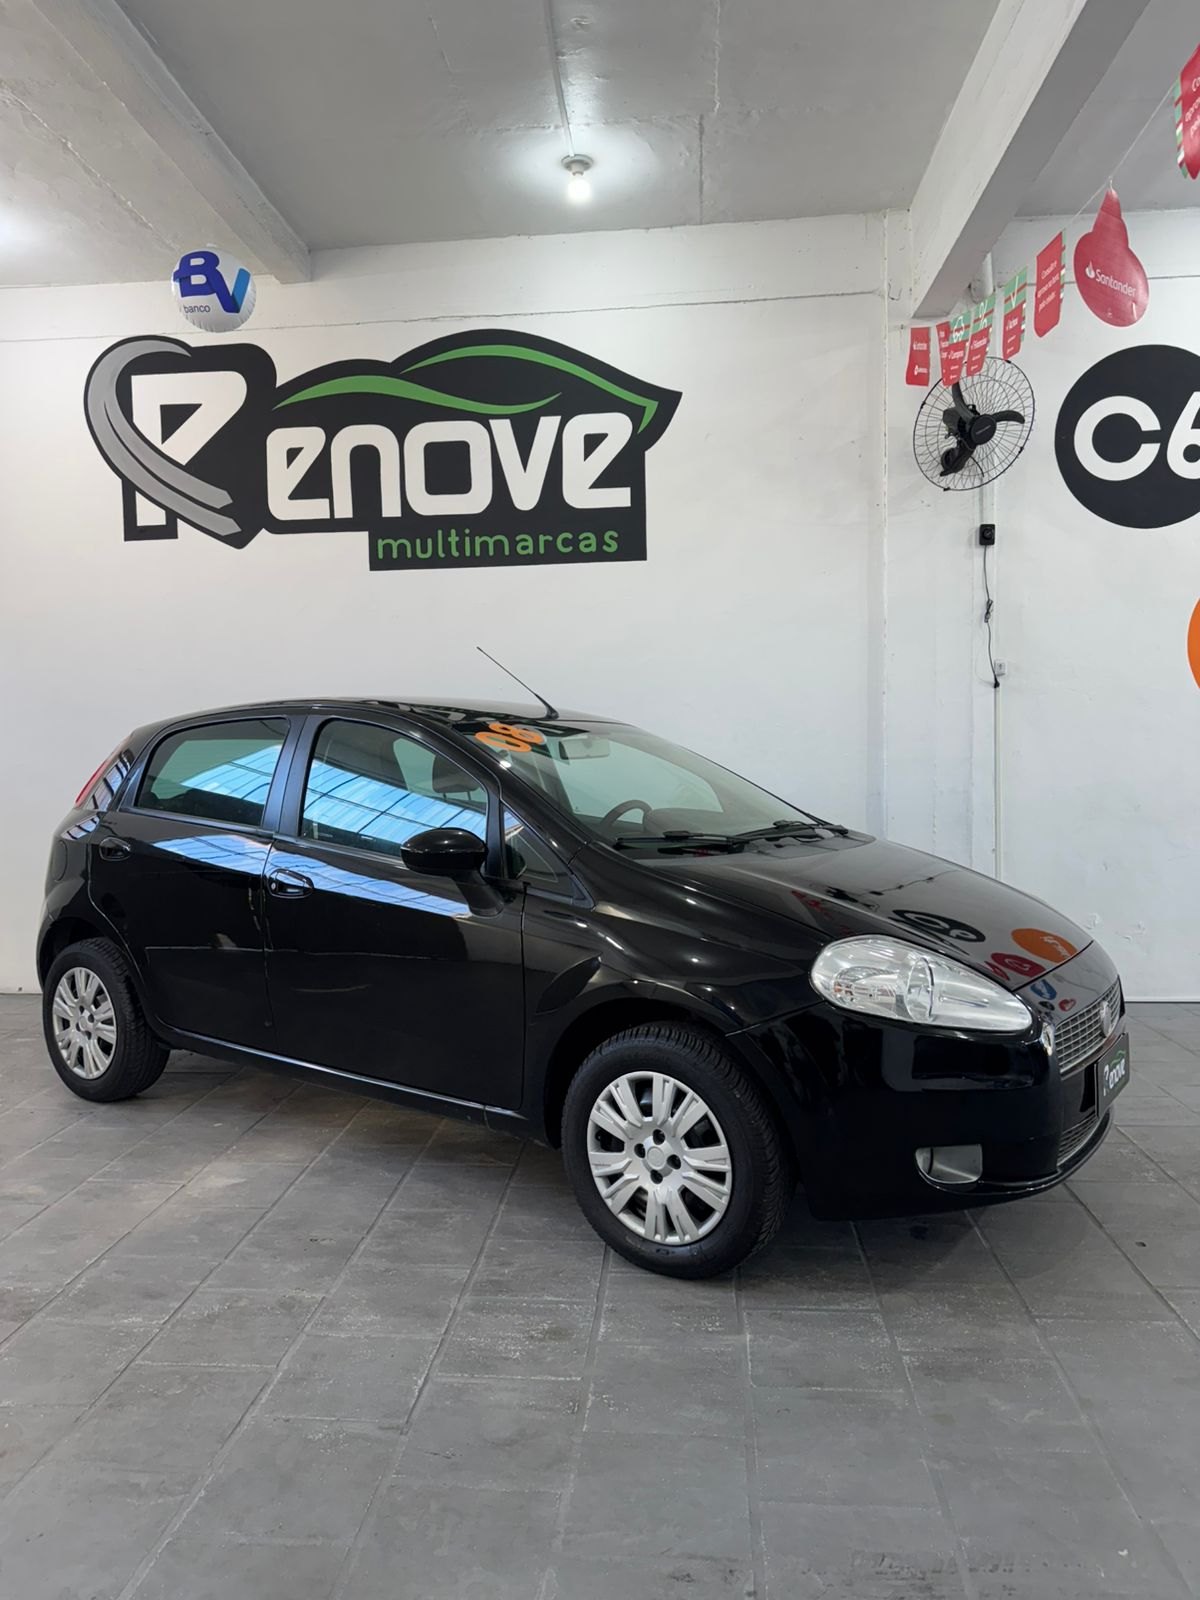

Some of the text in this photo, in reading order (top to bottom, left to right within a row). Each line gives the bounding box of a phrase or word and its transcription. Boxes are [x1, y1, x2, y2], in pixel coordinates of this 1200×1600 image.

[173, 251, 251, 313] BV
[1095, 268, 1137, 297] Santander
[183, 304, 211, 314] banco
[130, 370, 633, 528] Renove
[1073, 390, 1200, 481] C6
[377, 528, 619, 559] multimarcas
